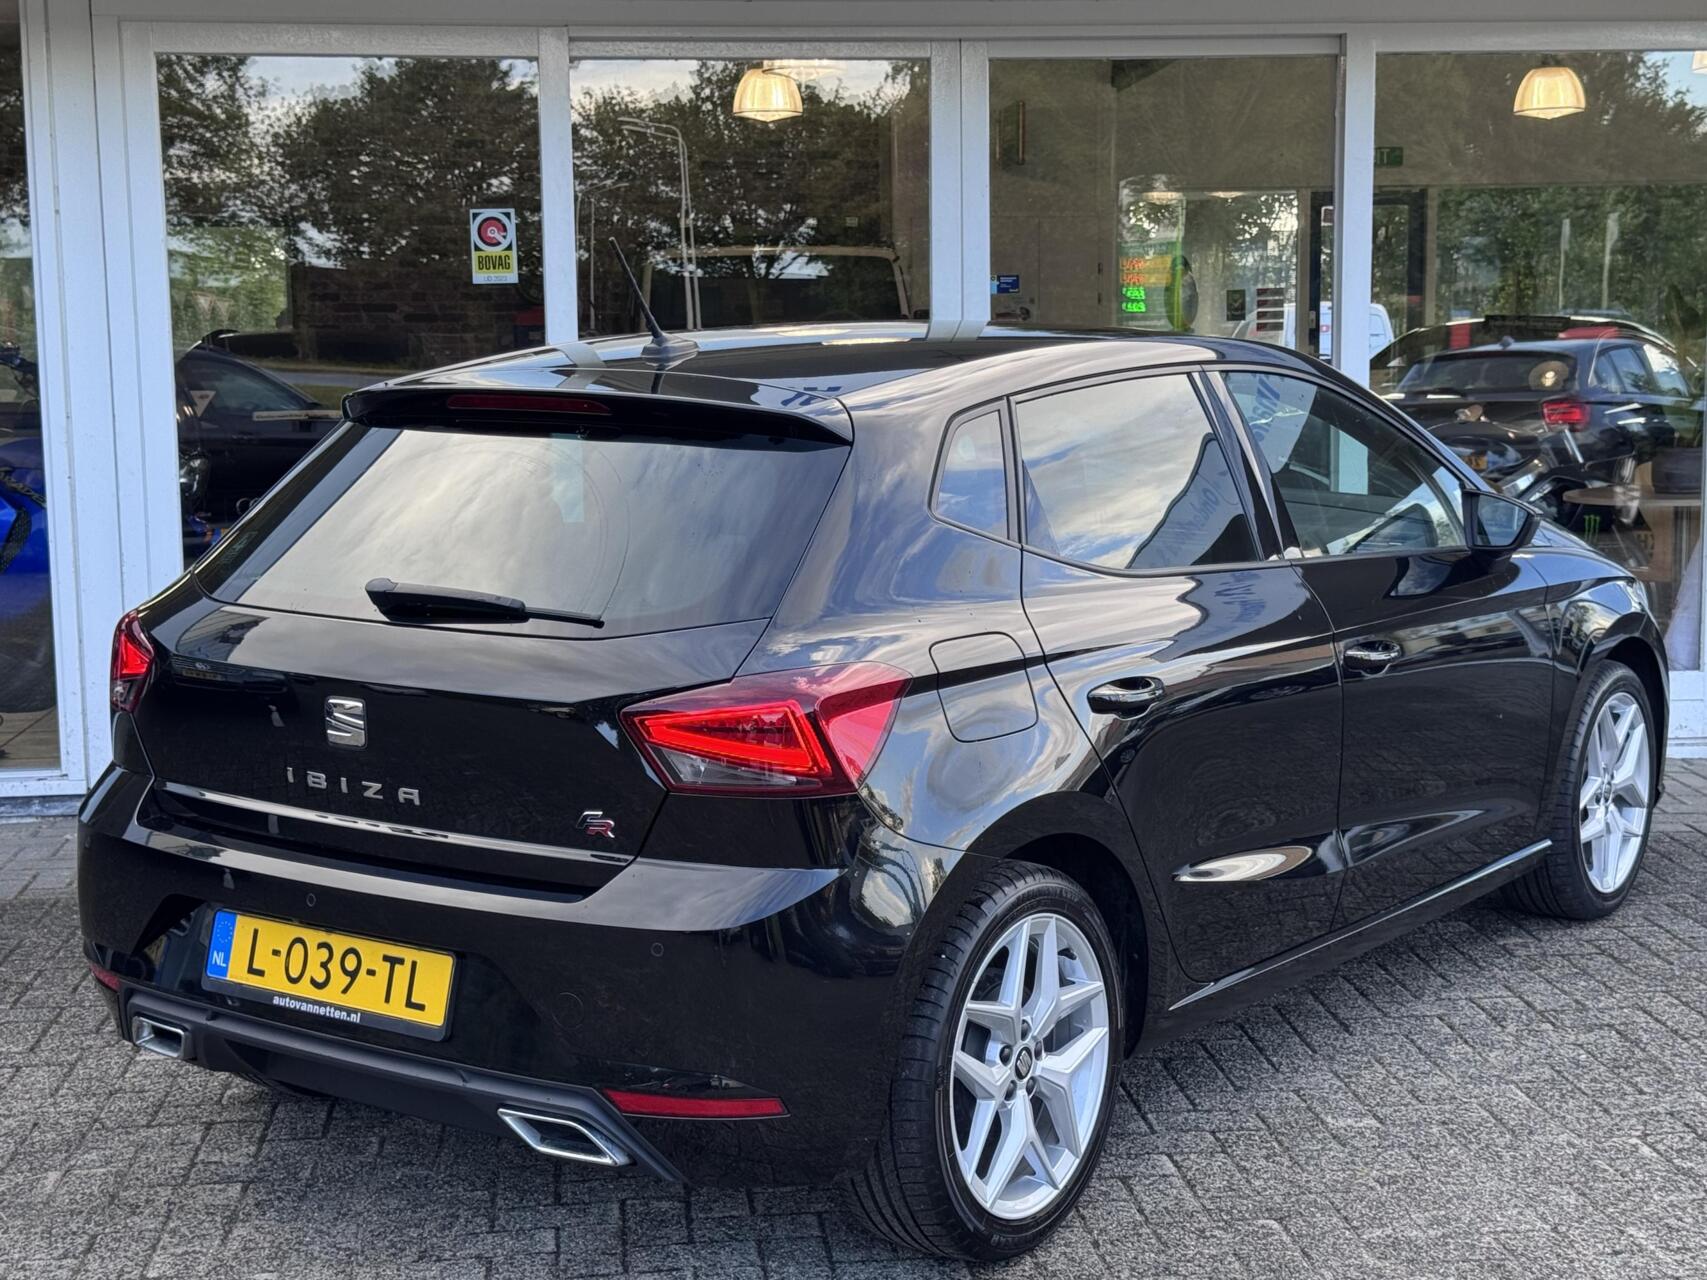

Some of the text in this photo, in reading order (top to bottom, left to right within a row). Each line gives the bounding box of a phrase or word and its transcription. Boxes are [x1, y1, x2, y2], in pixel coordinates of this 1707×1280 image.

[477, 254, 511, 271] BOVAG
[286, 766, 421, 806] IBIZA
[576, 811, 615, 838] FR
[212, 951, 227, 967] NL
[246, 928, 427, 1012] L-039-TL
[272, 995, 362, 1024] autovannetten.nl
